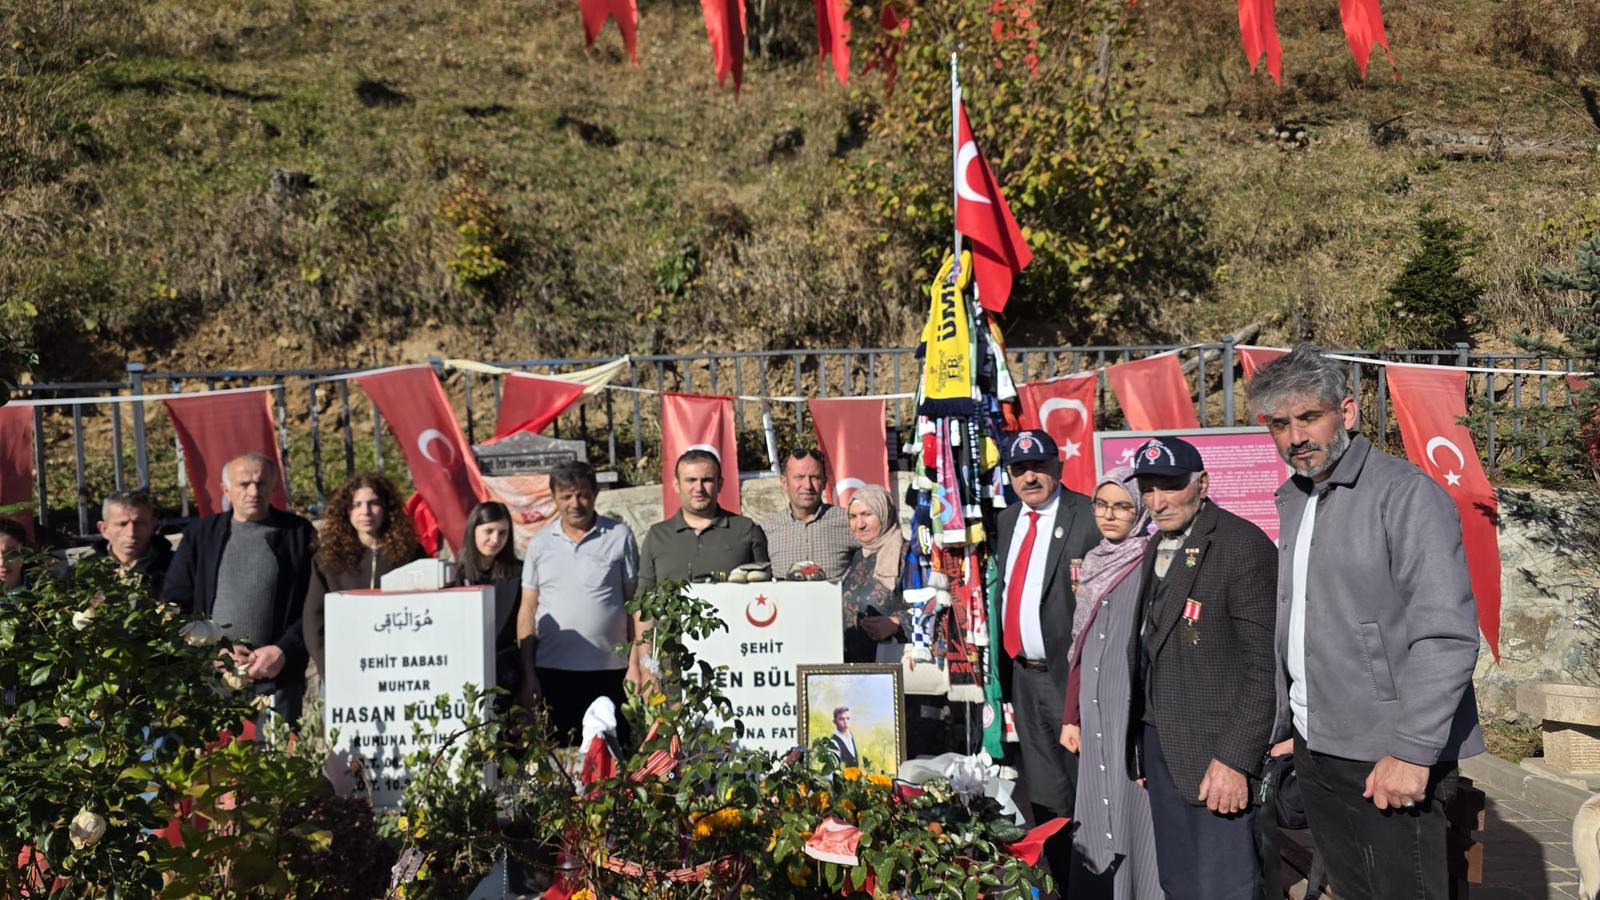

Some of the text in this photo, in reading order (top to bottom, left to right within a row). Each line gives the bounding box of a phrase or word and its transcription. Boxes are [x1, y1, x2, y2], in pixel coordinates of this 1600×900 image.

[740, 639, 784, 656] ŞEHİT
[360, 653, 447, 671] ŞEHİT BABASI
[753, 666, 795, 688] BÜL
[378, 680, 431, 693] MUHTAR
[332, 704, 395, 724] HASAN
[771, 727, 796, 739] FAT
